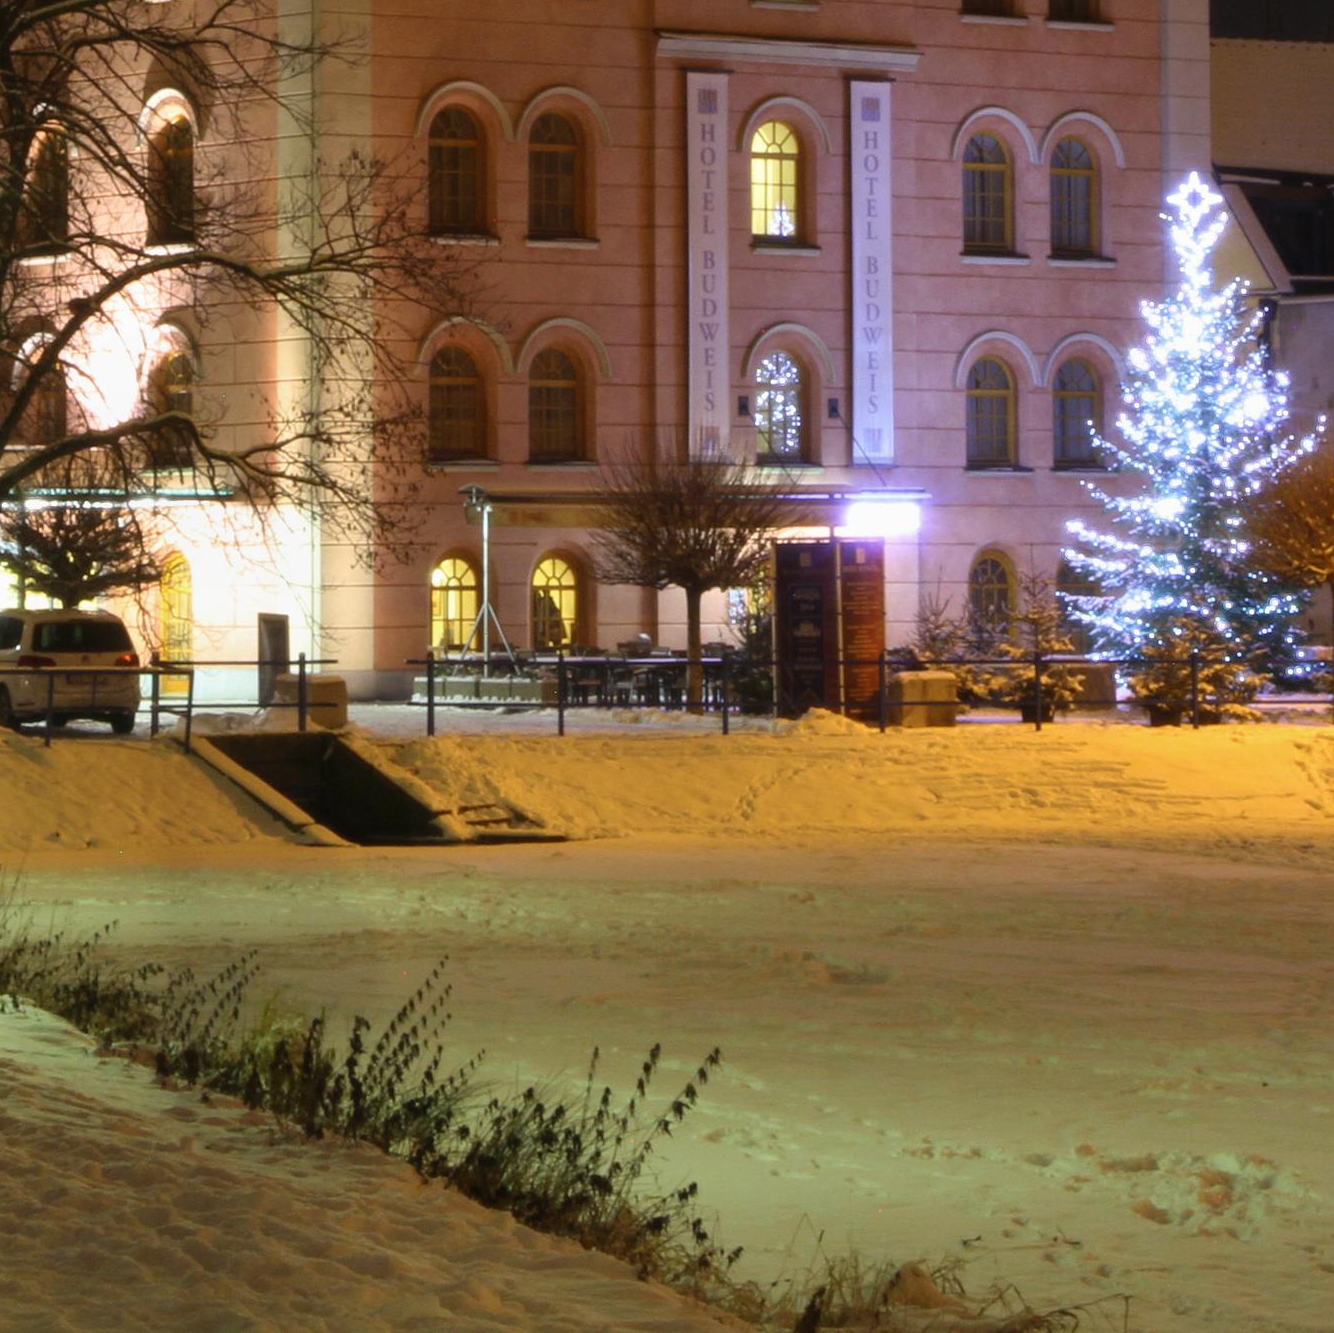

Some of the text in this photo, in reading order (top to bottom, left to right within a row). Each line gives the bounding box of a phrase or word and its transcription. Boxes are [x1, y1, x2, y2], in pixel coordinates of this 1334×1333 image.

[698, 123, 719, 412] HOTEL BUDWEIS
[863, 130, 883, 415] HOTEL BUDWEIS
